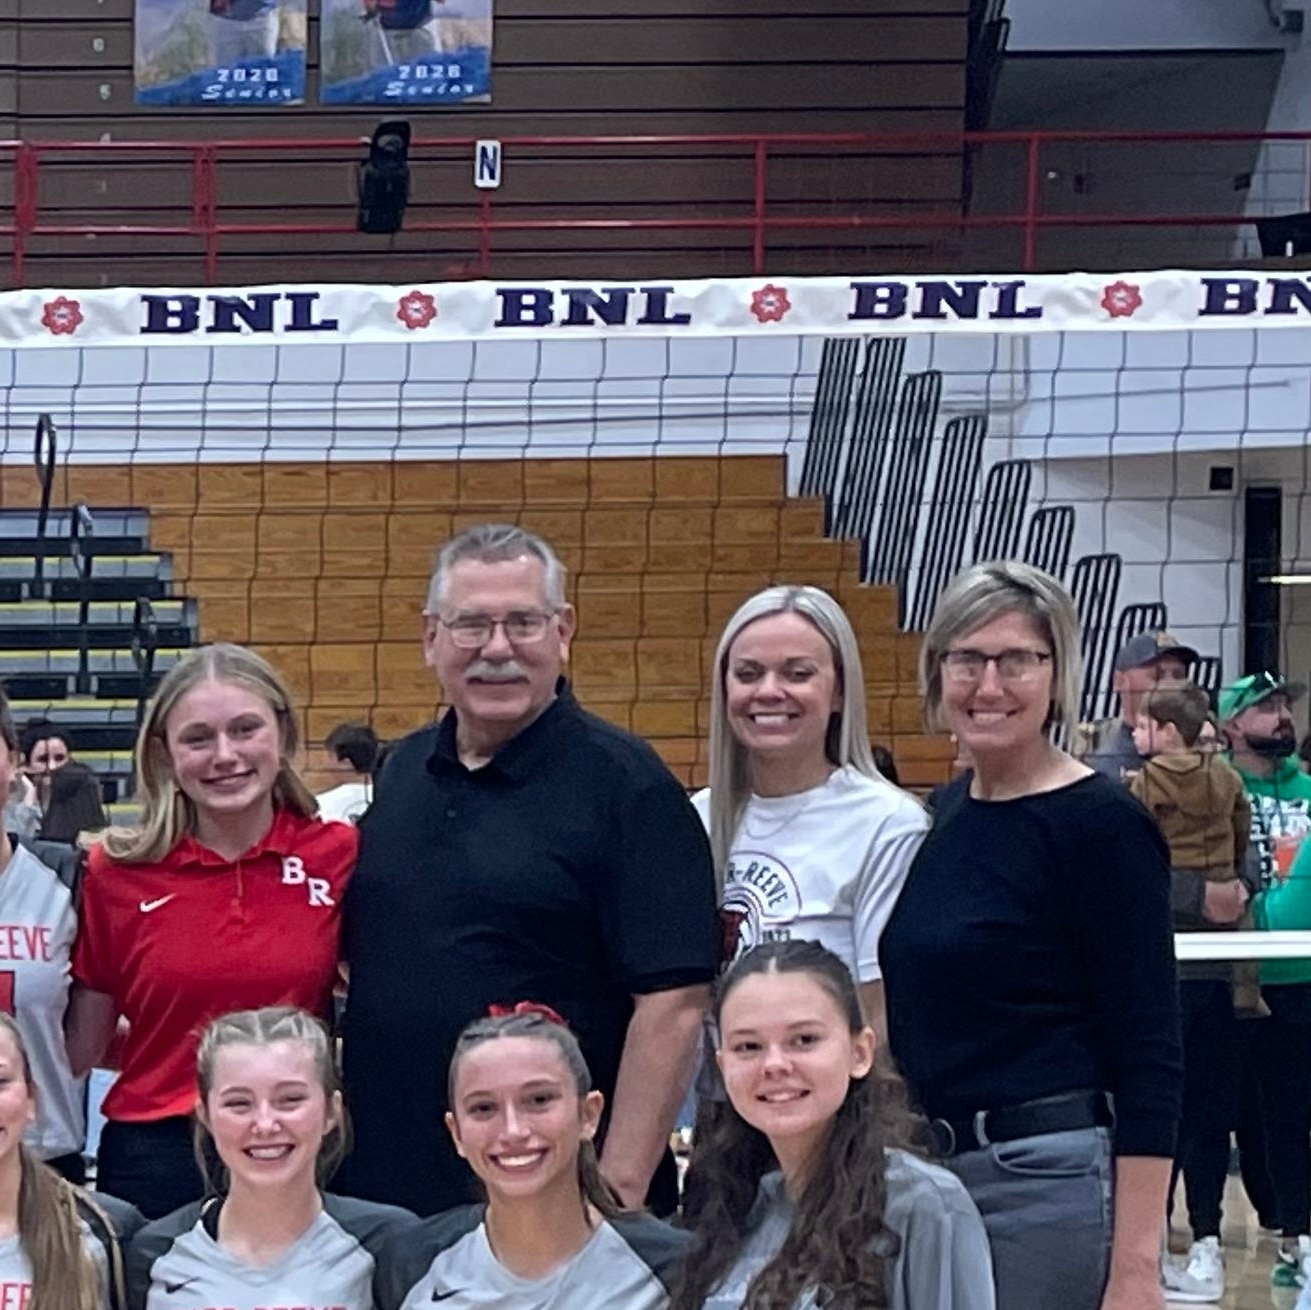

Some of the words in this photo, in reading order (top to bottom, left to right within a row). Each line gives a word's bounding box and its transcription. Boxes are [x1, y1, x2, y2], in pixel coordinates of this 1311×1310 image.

[479, 145, 498, 181] N
[141, 293, 337, 333] BNL
[495, 287, 691, 327] BNL
[848, 282, 1042, 320] BNL
